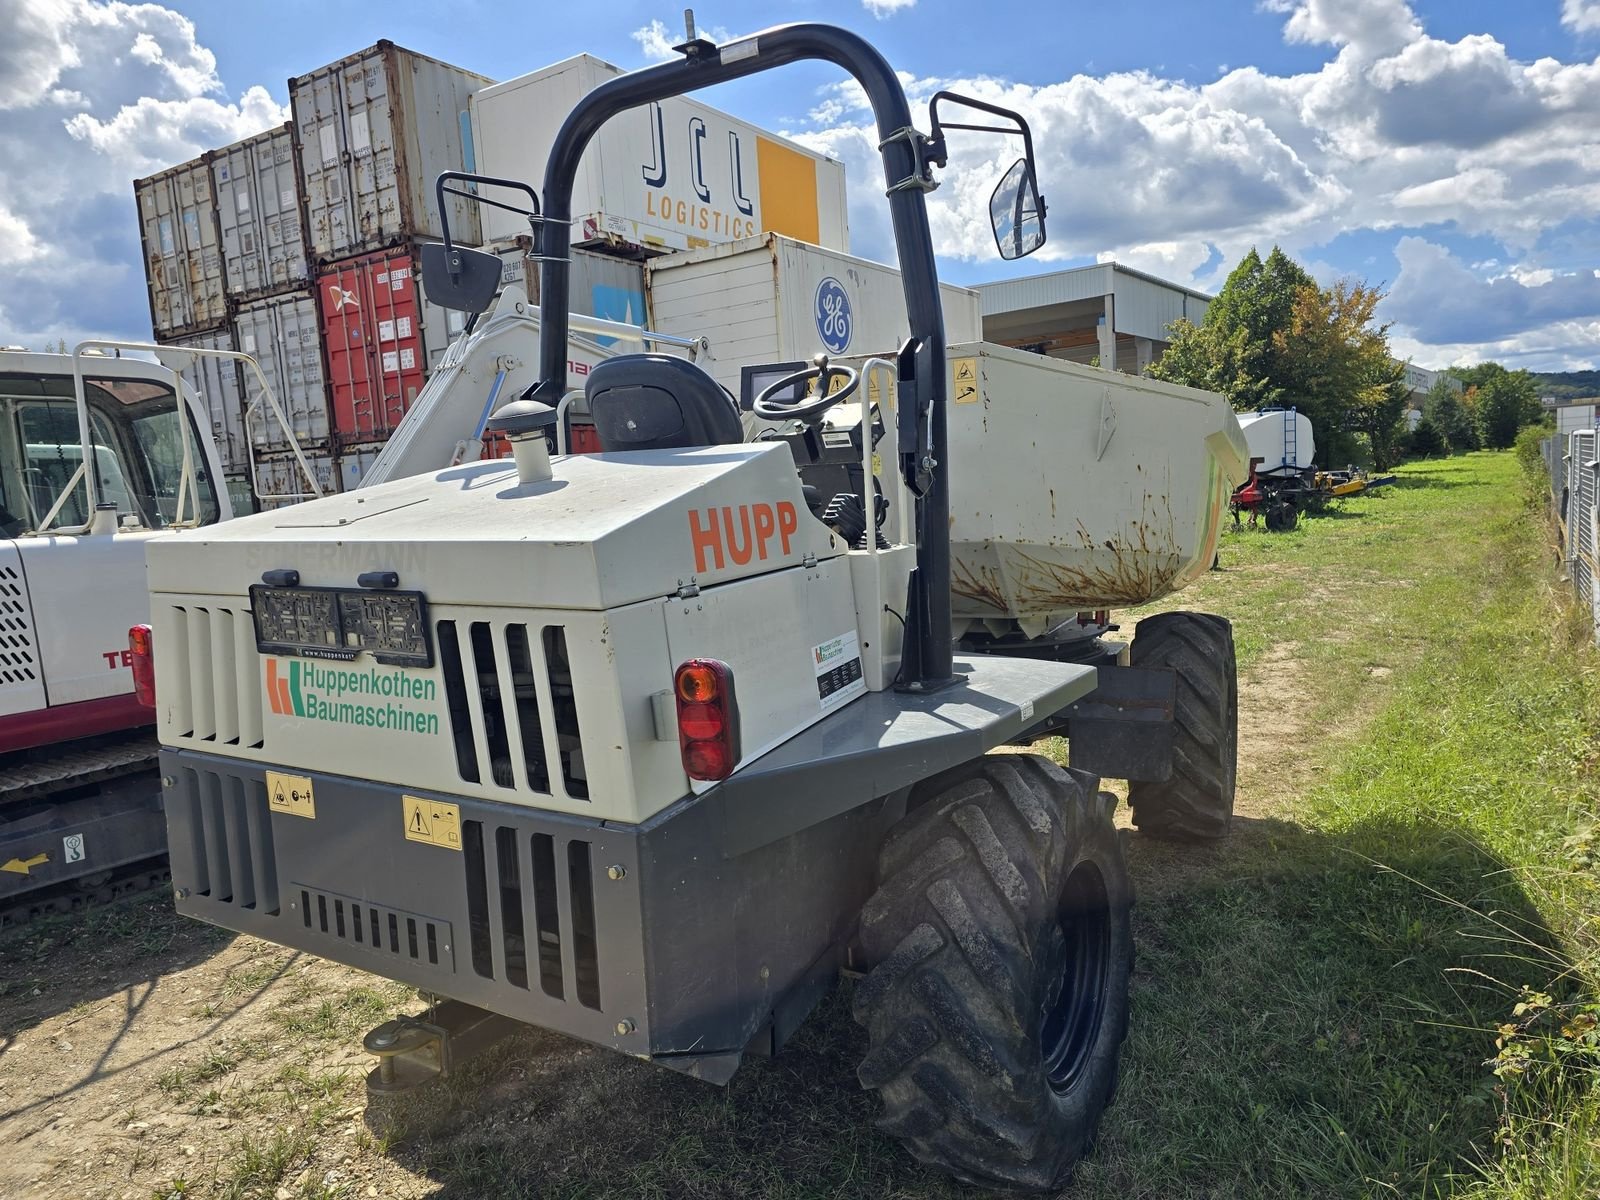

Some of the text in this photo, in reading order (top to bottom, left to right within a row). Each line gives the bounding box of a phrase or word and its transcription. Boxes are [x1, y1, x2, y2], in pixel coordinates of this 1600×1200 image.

[642, 100, 753, 216] JCL
[647, 191, 754, 239] LOGISTICS
[688, 501, 797, 573] HUPP
[303, 661, 436, 700] Huppenkothen
[306, 693, 438, 735] Baumaschinen
